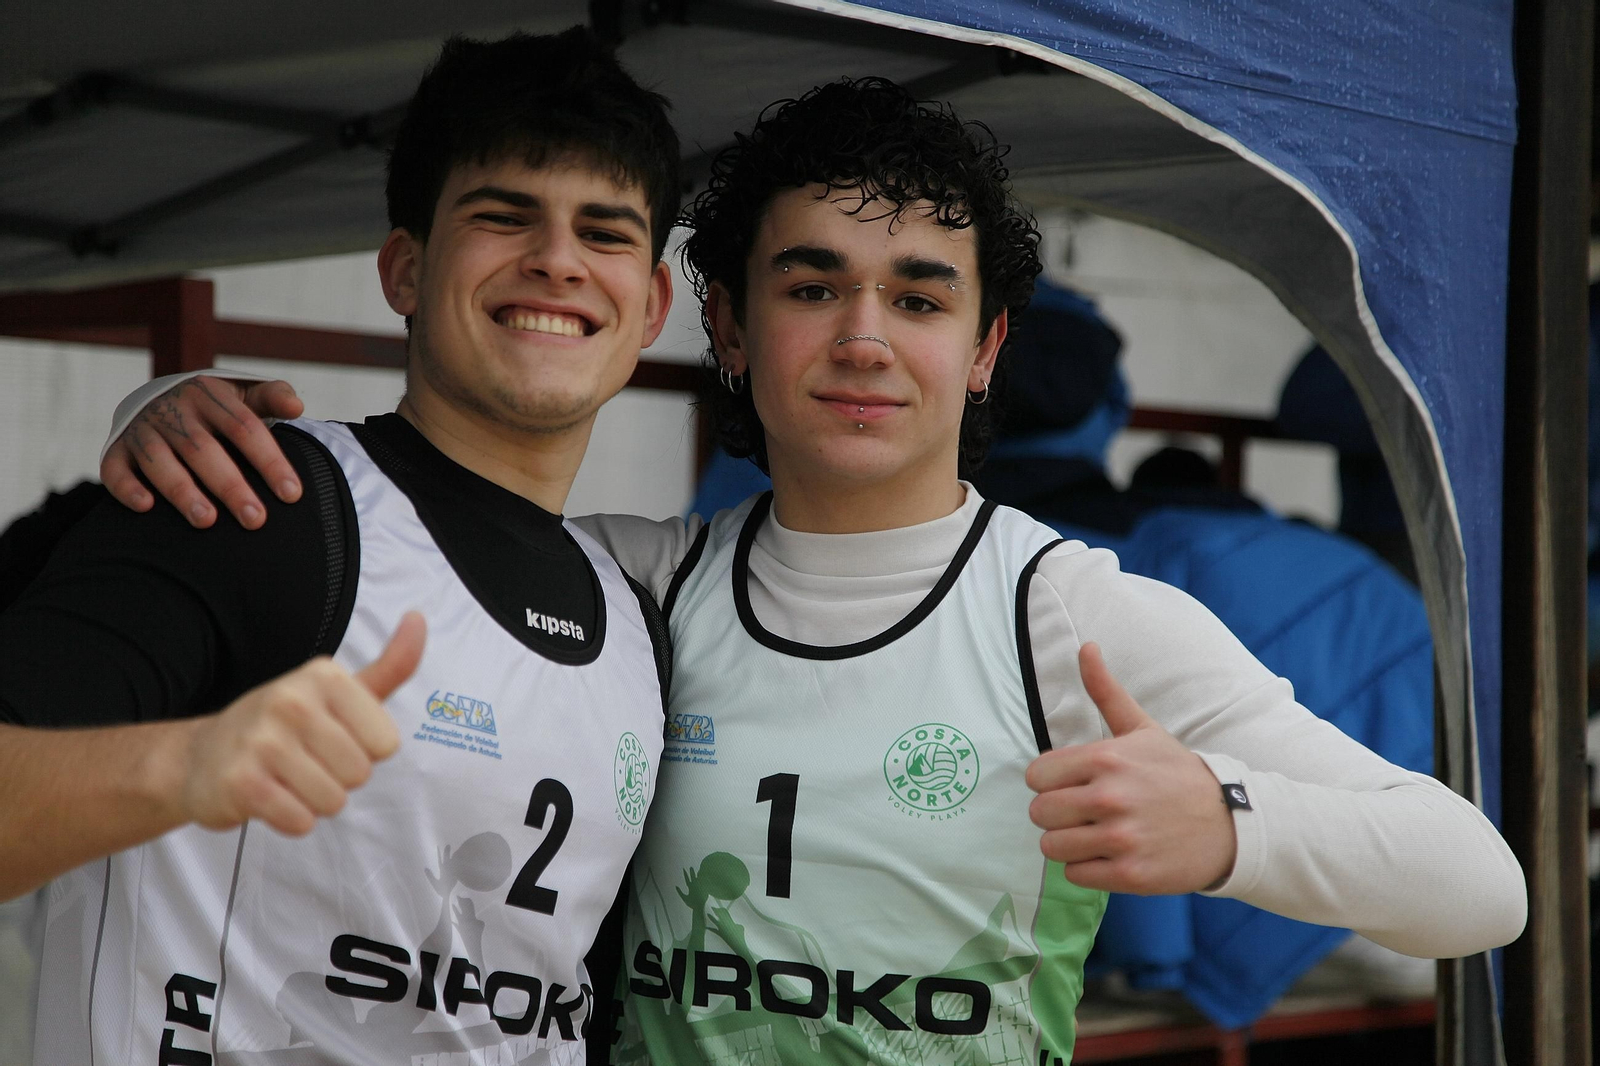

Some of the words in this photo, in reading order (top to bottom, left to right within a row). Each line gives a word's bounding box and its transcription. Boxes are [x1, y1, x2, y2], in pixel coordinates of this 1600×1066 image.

[525, 608, 585, 641] kipsta
[413, 732, 427, 741] del
[428, 735, 467, 750] Principado
[468, 745, 477, 753] de
[478, 747, 502, 760] Asturias
[421, 723, 463, 739] Federación
[464, 734, 473, 742] de
[474, 736, 499, 749] Voleibol
[681, 746, 690, 754] de
[690, 747, 716, 756] Voleibol
[898, 728, 971, 761] COSTA
[620, 738, 647, 774] COSTA
[691, 756, 718, 765] Asturias
[619, 787, 647, 820] NORTE
[892, 774, 968, 807] NORTE
[887, 795, 922, 819] VOLEY
[930, 807, 967, 821] PLAYA
[504, 778, 574, 916] 2
[755, 772, 800, 899] 1
[629, 939, 992, 1036] SIROKO
